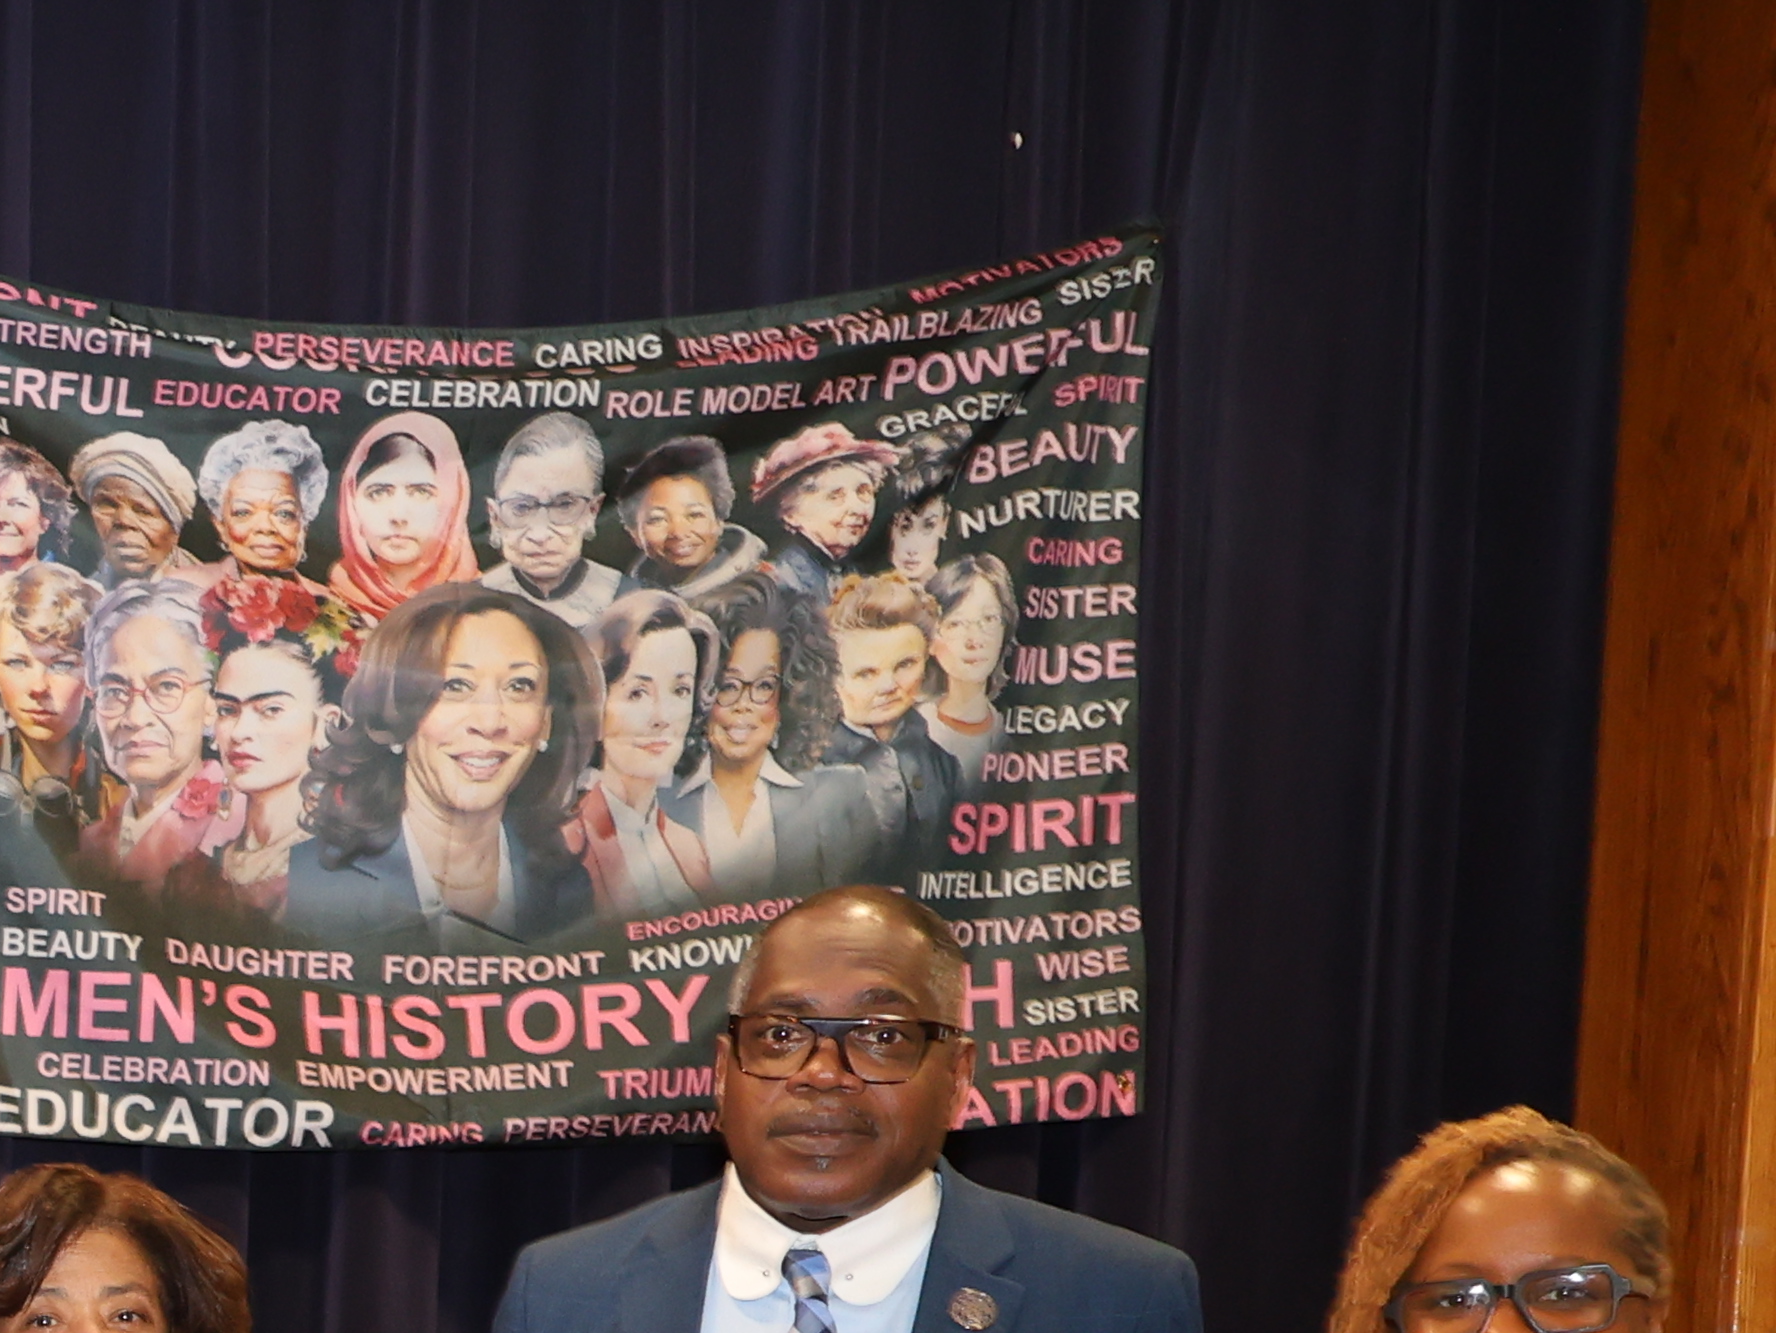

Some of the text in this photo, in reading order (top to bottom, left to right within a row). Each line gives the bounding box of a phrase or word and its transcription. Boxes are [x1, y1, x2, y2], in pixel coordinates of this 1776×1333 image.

[908, 236, 1123, 304] MOTIVATORS
[831, 298, 1042, 346] TRAILBLAZING
[253, 331, 515, 367] PERSEVERANCE
[534, 334, 663, 369] CARING
[674, 335, 820, 369] ADING
[154, 379, 341, 414] EDUCATOR
[365, 378, 601, 408] CELEBRATION
[606, 382, 806, 419] ROLE MODEL
[814, 374, 876, 406] ART
[1053, 374, 1145, 408] SPIRIT
[878, 391, 1028, 438] GRACEFL
[966, 422, 1139, 484] BEAUTY
[957, 487, 1141, 539] NURTURER
[1026, 536, 1124, 567] CARING
[1024, 583, 1138, 620] SISTER
[1014, 638, 1137, 686] MUSE
[1004, 698, 1131, 734] LEGACY
[981, 742, 1130, 783] PIONEER
[949, 791, 1137, 855] SPIRIT
[919, 858, 1132, 900] INTELLIGENCE
[5, 887, 106, 917] SPIRIT
[626, 897, 803, 941] ENCOURAGI
[1, 927, 143, 962] BEAUTY
[950, 904, 1142, 948] OTIVATORS
[165, 937, 354, 981] DAUGHTER
[383, 950, 605, 986] FOREFRONT
[1035, 945, 1131, 982] WISE
[301, 974, 711, 1061] HISTORY
[1023, 986, 1140, 1026] SISTER
[988, 1024, 1140, 1067] LEADING
[36, 1051, 270, 1087] CELEBRATION
[296, 1060, 575, 1097] EMPOWERMENT
[596, 1066, 717, 1100] TRIUM
[360, 1119, 484, 1148] CARING
[504, 1110, 717, 1144] PERSEVERAN
